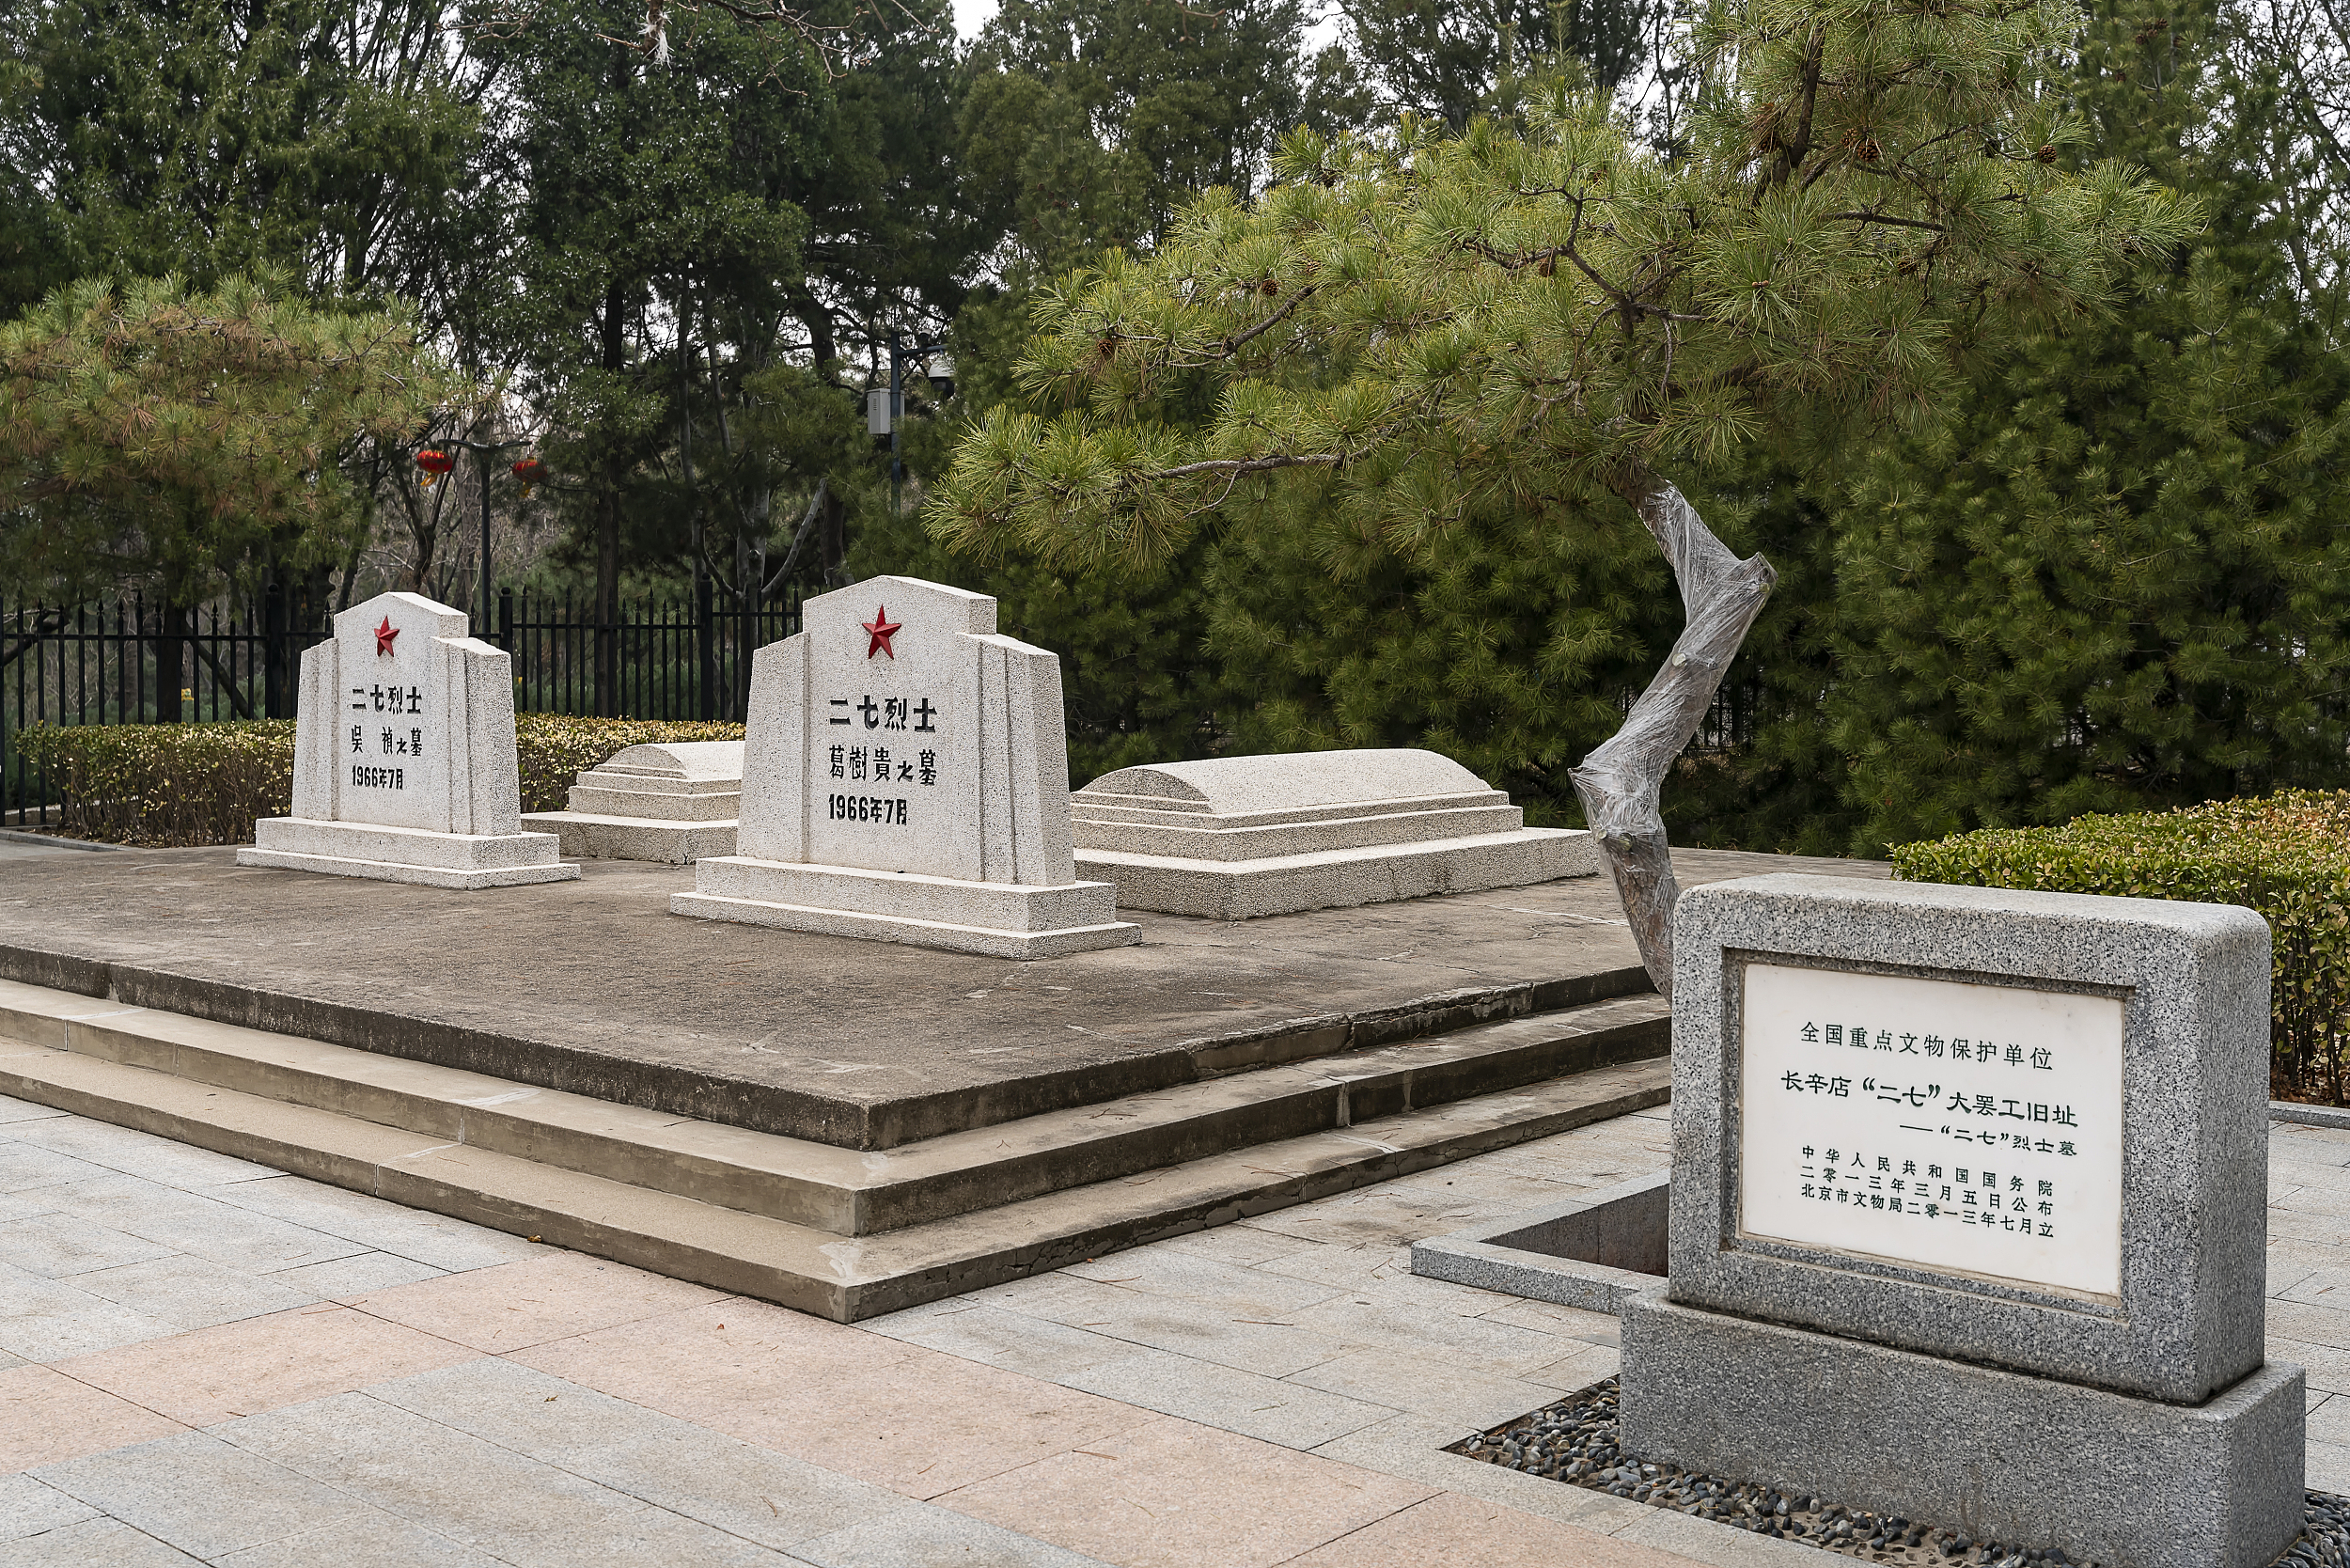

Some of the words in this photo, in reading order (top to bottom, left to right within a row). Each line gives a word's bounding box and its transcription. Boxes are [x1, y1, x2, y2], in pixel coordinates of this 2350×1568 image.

[352, 684, 422, 714] 二七烈士
[829, 695, 938, 733] 二七烈士
[352, 764, 404, 791] 1966年7月
[828, 793, 908, 826] 1966年7月
[1800, 1021, 2053, 1071] 全国重点文物保护单位
[1800, 1165, 2054, 1216] 二零一三年三月五日公布
[1802, 1145, 2054, 1197] 中华人民共和国国务院
[1801, 1183, 2055, 1238] 北京市文物局二零一三年七月立
